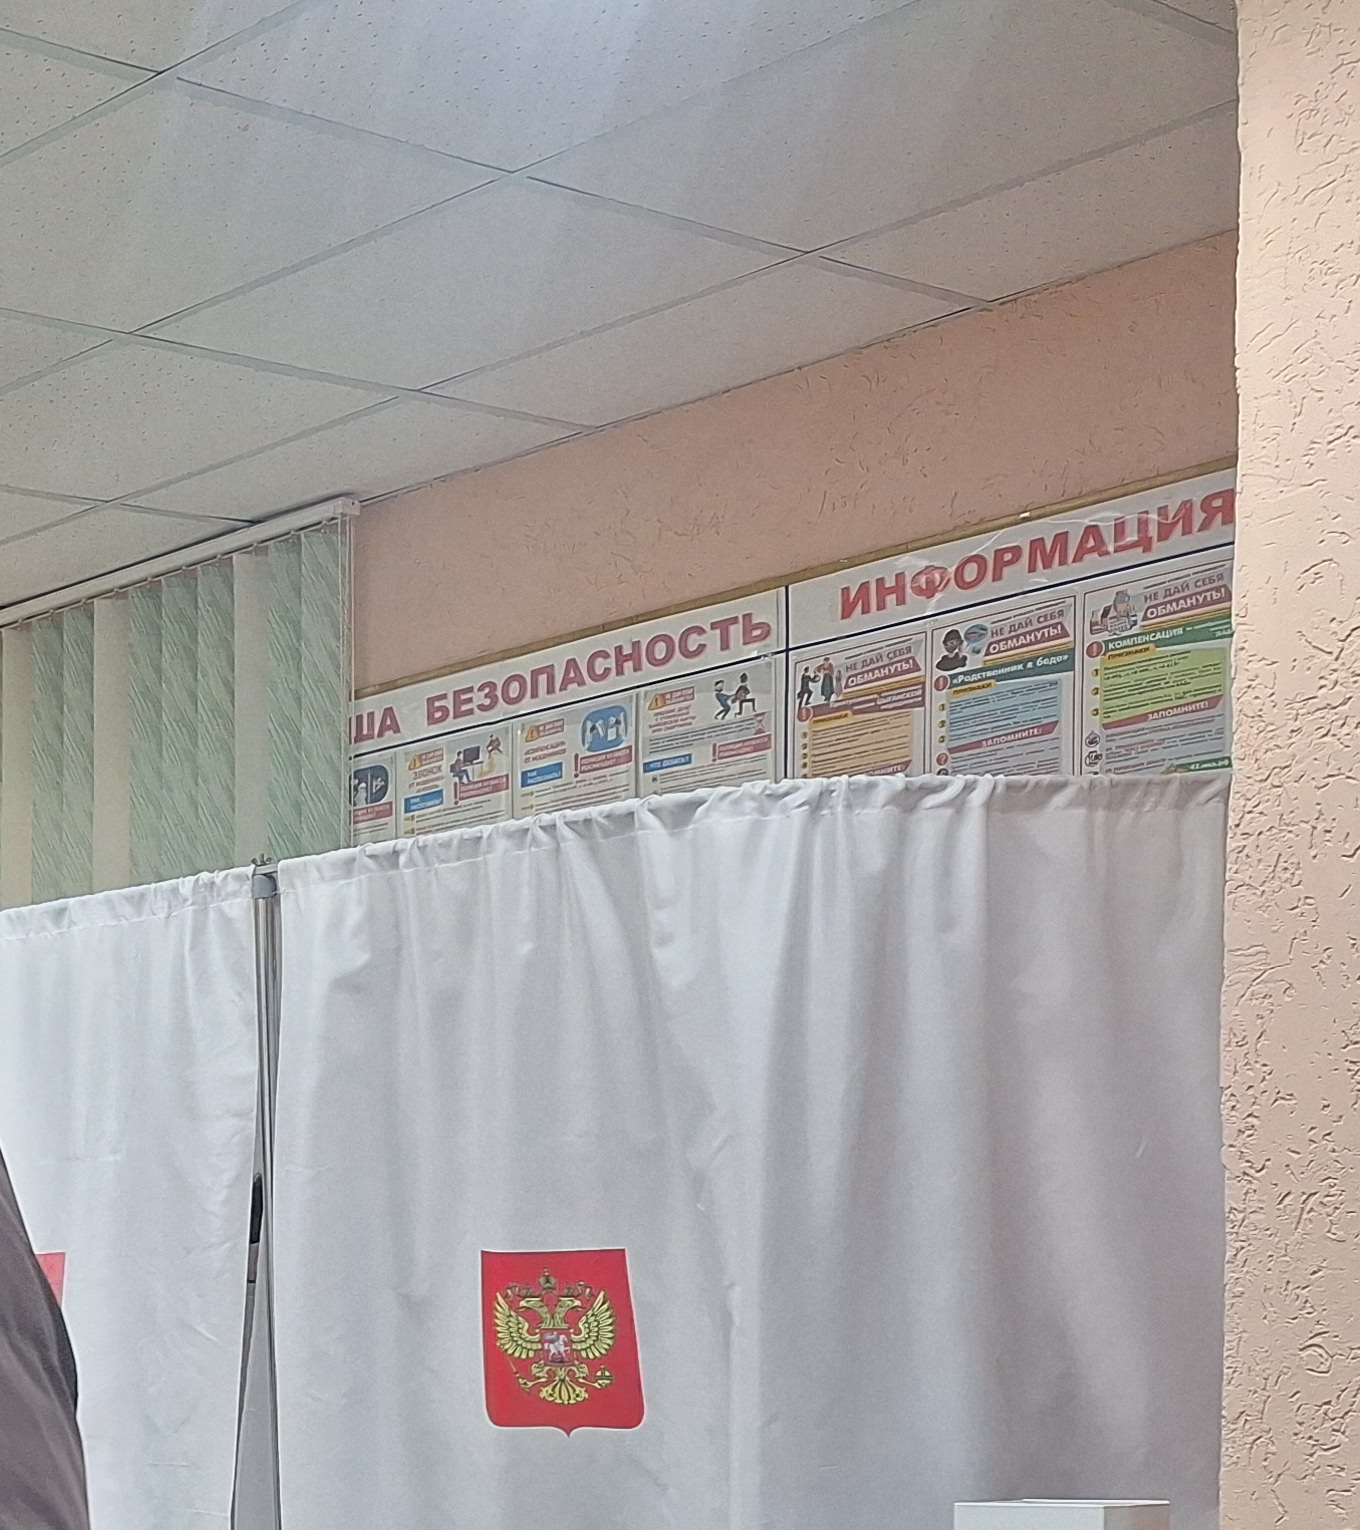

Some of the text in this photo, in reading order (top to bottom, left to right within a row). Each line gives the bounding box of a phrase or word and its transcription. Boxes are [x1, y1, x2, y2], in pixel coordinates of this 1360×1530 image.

[840, 487, 1235, 620] ИНФОРМАЦИЯ
[1143, 573, 1224, 603] НЕ ДАЙ СЕБЯ
[1146, 588, 1226, 618] ОБМАНУТЬ!
[989, 623, 1063, 654] ОБМАНУТЬ!
[991, 609, 1065, 639] НЕ ДАЙ СЕБЯ
[1108, 627, 1184, 650] КОМПЕНСАЦИЯ
[426, 612, 772, 727] БЕЗОПАСНОСТЬ
[846, 645, 912, 673] НЕ ДАЙ СЕБЯ
[848, 659, 914, 686] ОБМАНУТЬ!
